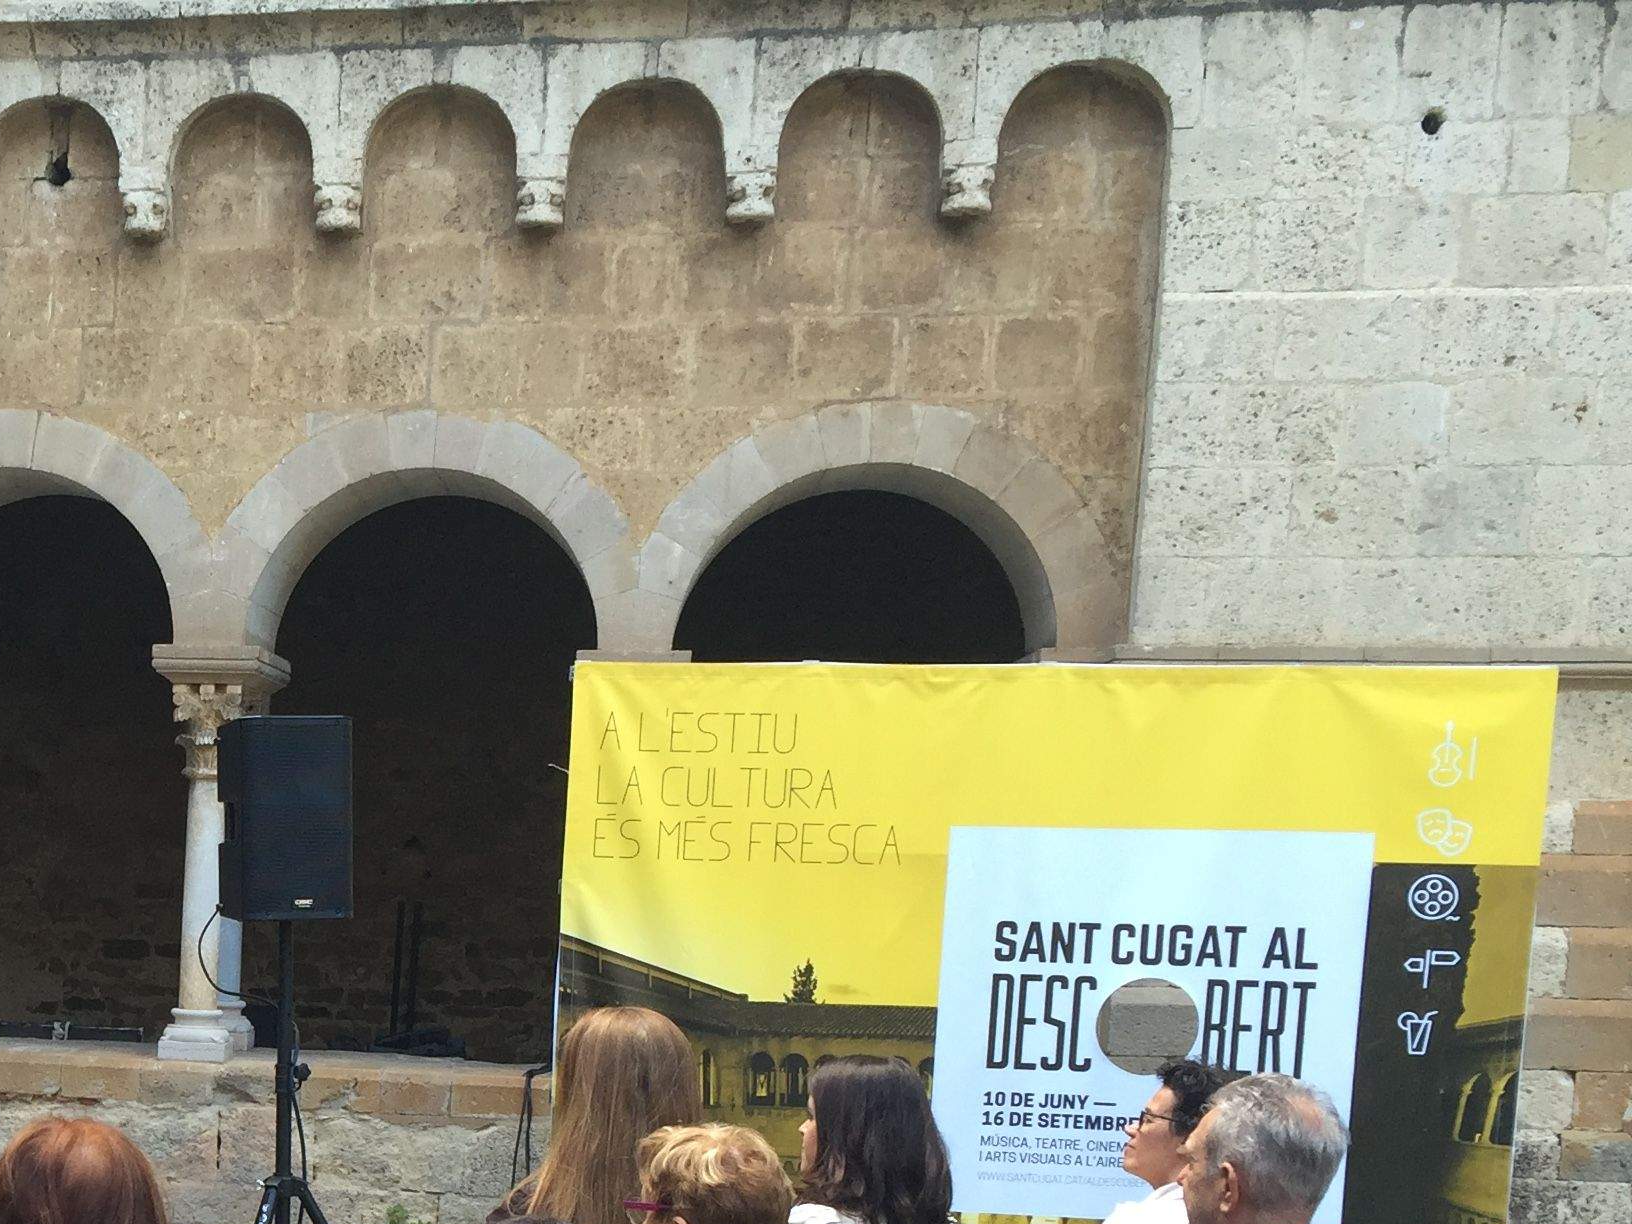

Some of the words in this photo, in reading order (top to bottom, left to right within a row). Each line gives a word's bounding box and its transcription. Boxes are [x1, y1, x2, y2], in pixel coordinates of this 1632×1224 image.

[599, 711, 621, 751] A
[637, 707, 799, 754] L'ESTIU
[596, 765, 643, 806] LA
[661, 766, 838, 810] CULTURA
[593, 813, 643, 860] ÉS
[657, 816, 733, 862] MÉS
[748, 822, 902, 866] FRESCA
[994, 920, 1102, 964] SANT
[1111, 923, 1248, 968] CUGAT
[1262, 926, 1318, 970] AL
[983, 1091, 1006, 1107] 10
[1010, 1092, 1035, 1108] DE
[1038, 1093, 1090, 1110] JUNY
[981, 1110, 1005, 1126] 16
[1009, 1111, 1033, 1128] DE
[978, 1150, 983, 1162] I
[984, 1151, 1017, 1163] ARTS
[1019, 1152, 1072, 1166] VISUALS
[1074, 1154, 1084, 1166] A
[1086, 1140, 1126, 1152] CINEM
